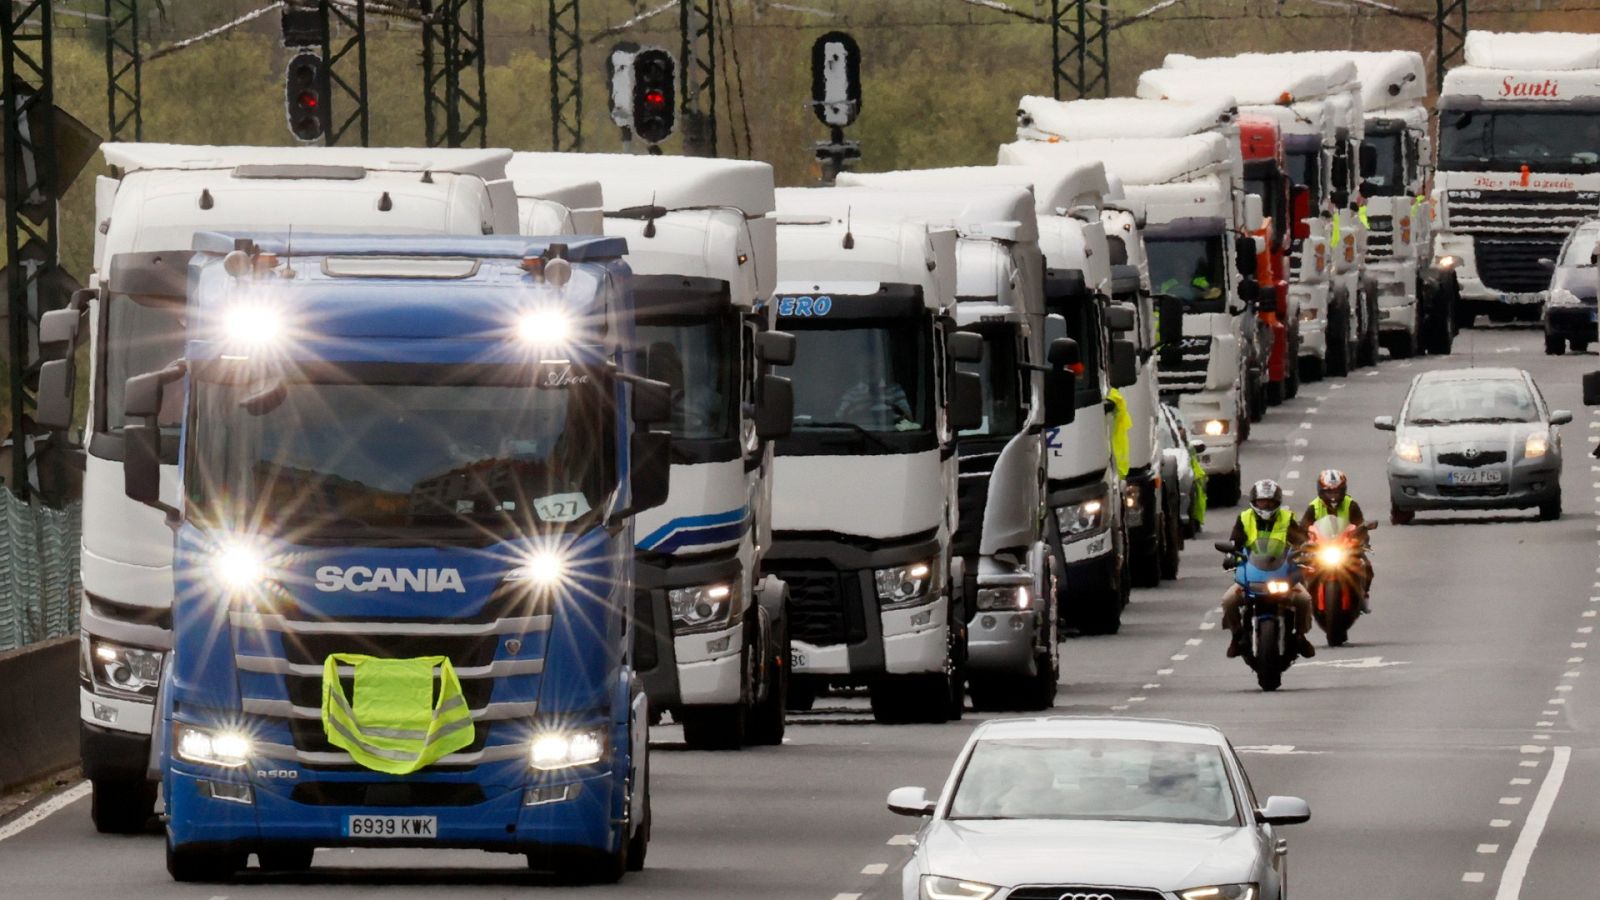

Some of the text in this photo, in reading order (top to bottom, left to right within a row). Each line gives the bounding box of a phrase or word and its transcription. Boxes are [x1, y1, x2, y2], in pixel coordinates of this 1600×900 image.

[1498, 75, 1559, 97] Santi
[777, 296, 832, 316] ERO
[541, 501, 578, 519] 127
[314, 566, 466, 593] SCANIA
[352, 818, 432, 835] 6939 KWK
